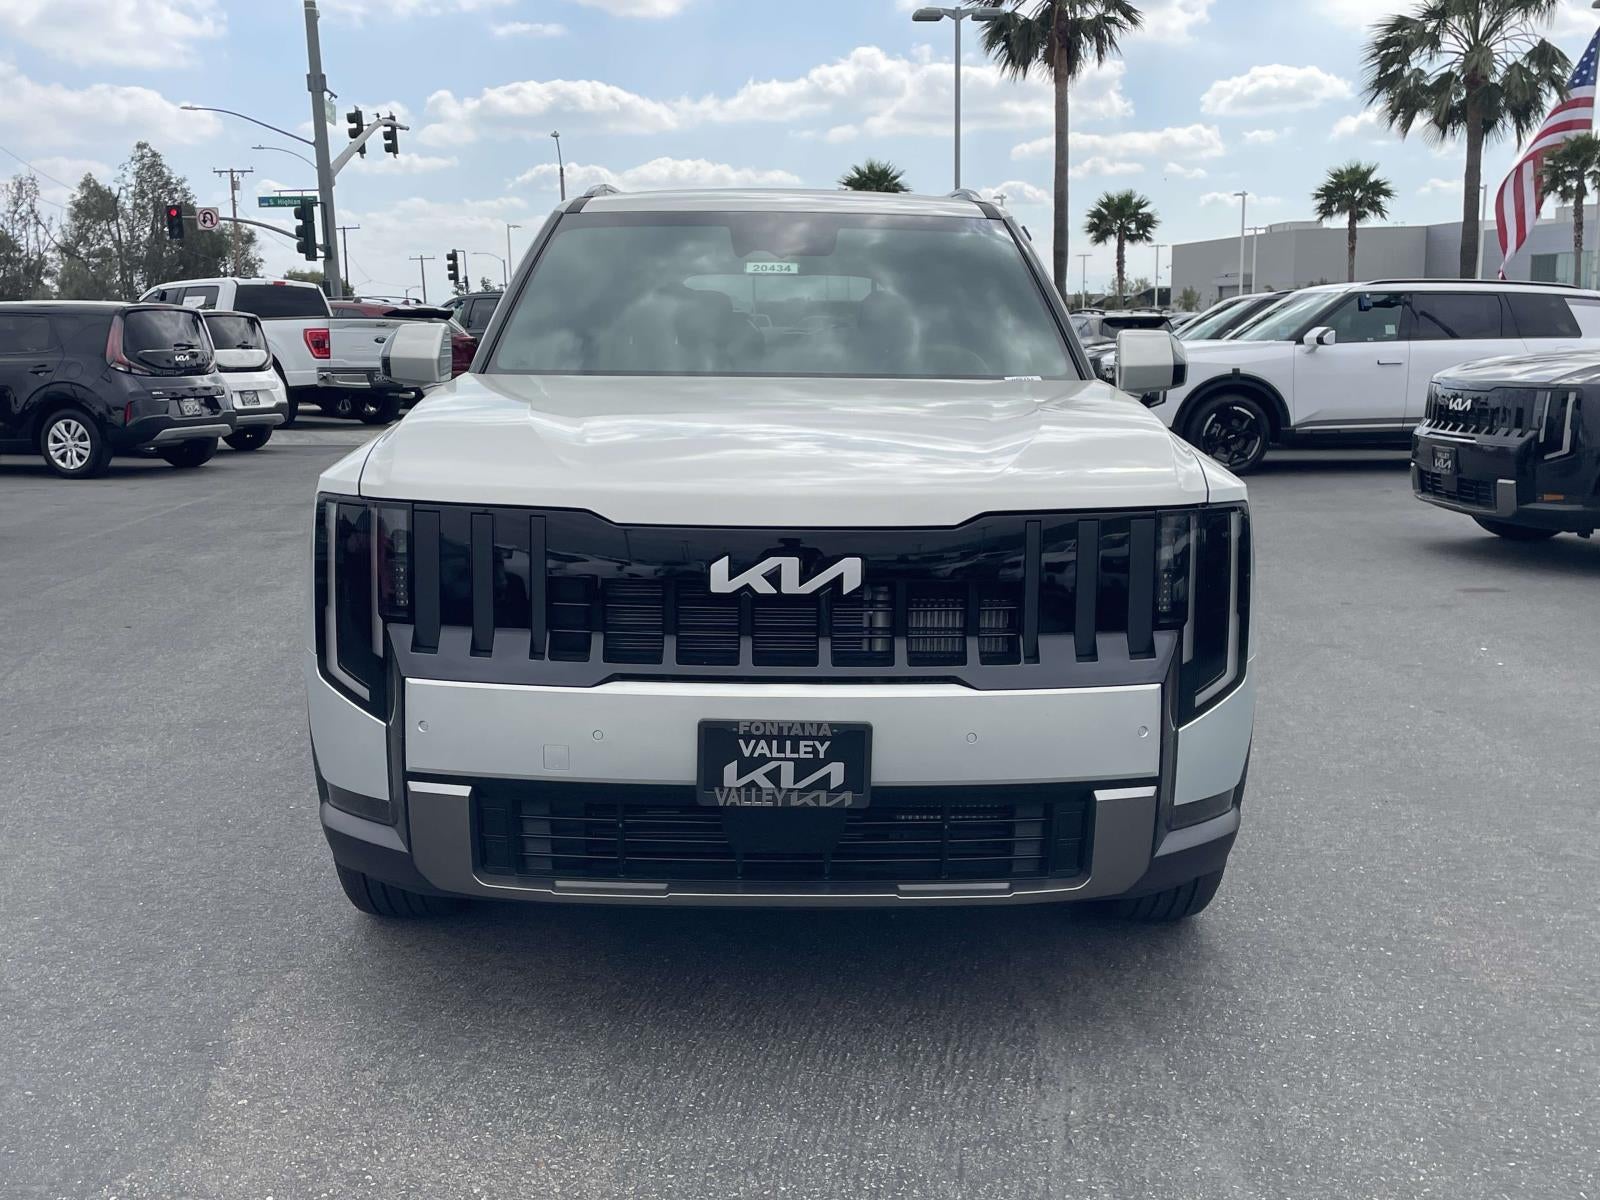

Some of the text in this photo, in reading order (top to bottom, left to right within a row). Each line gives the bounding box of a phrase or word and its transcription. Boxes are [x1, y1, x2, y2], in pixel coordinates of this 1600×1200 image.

[752, 264, 791, 272] 20434
[1449, 398, 1472, 411] KIA
[710, 555, 862, 596] KIA
[738, 721, 832, 737] FONTANA
[738, 739, 831, 759] VALLEY
[723, 759, 845, 790] KIA
[714, 787, 853, 807] VALLEY KIA
